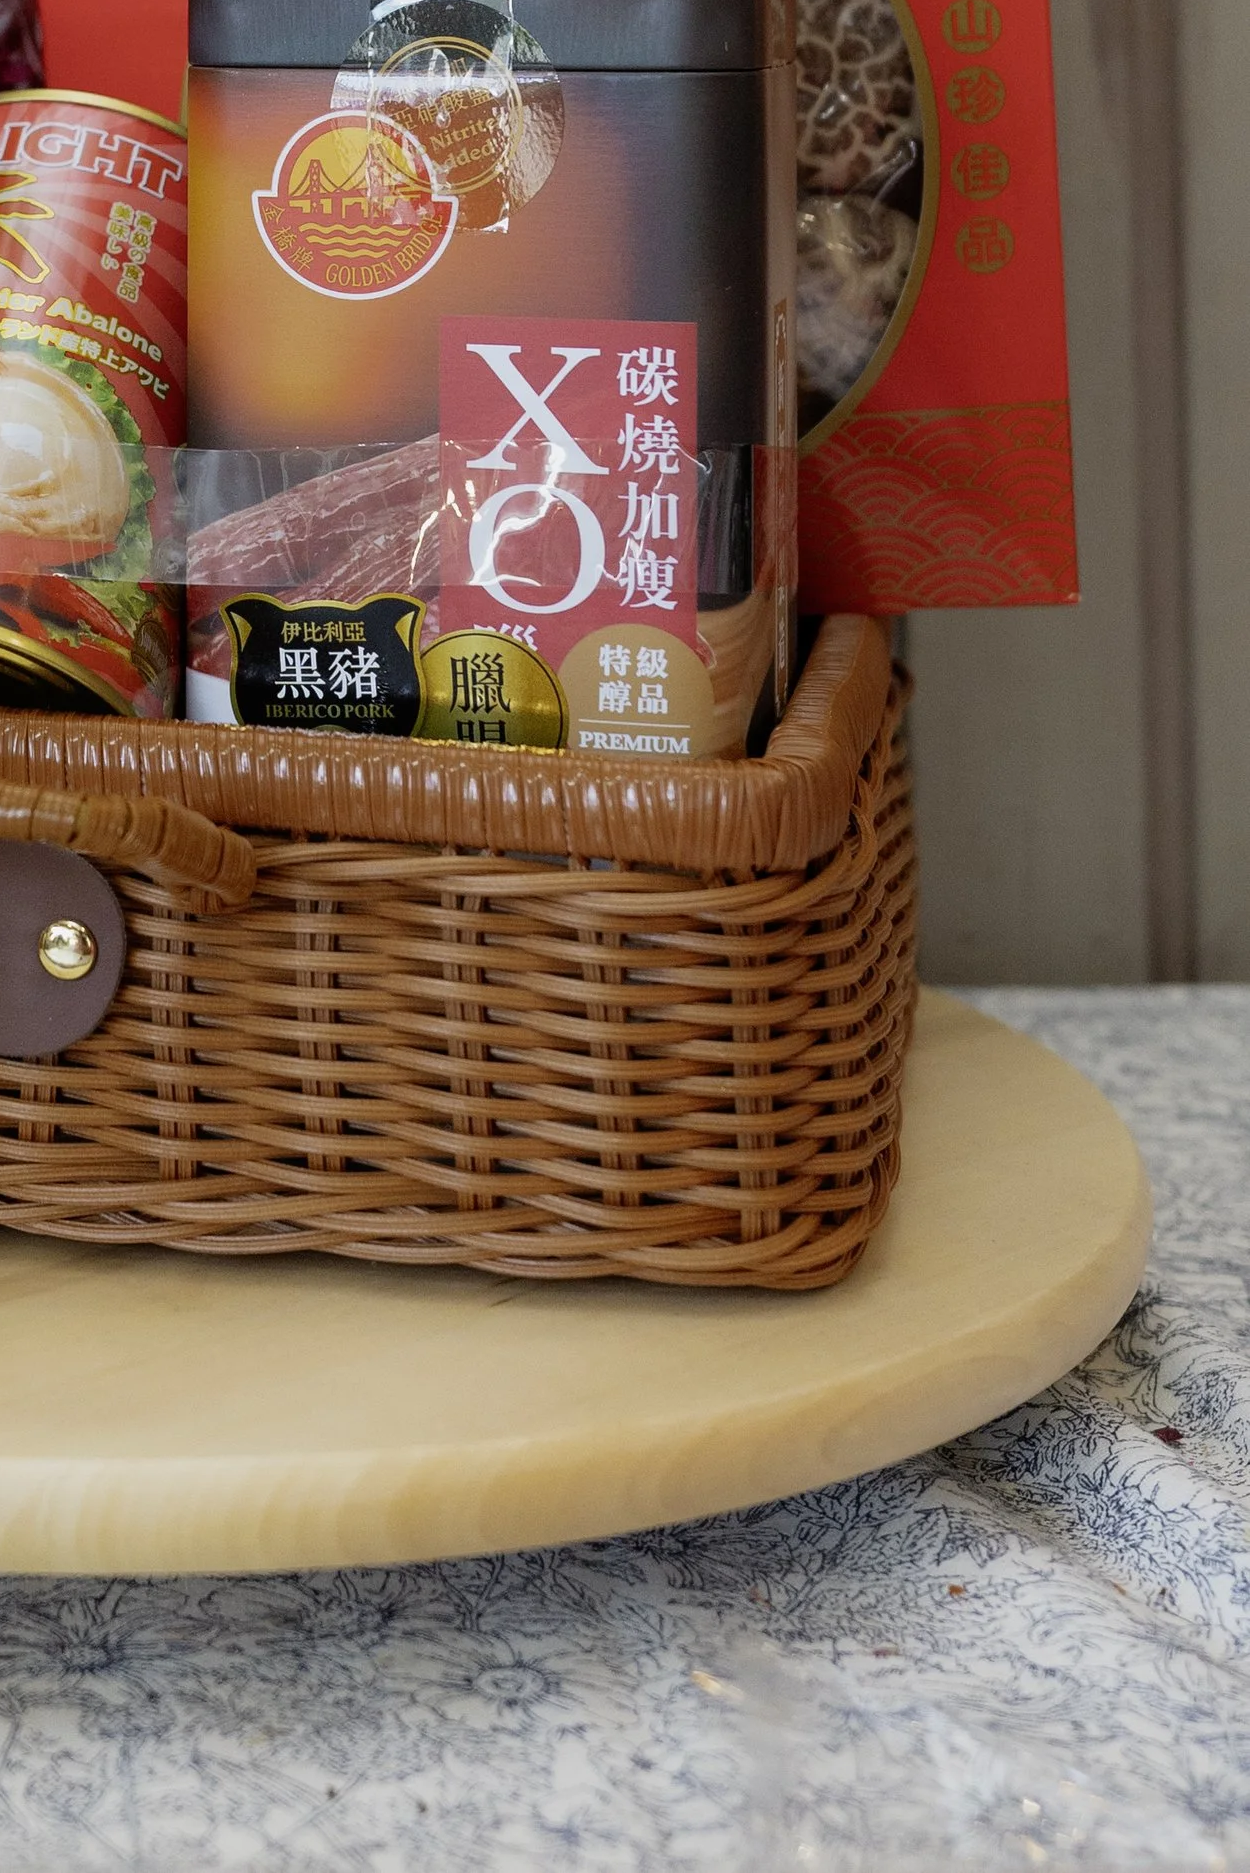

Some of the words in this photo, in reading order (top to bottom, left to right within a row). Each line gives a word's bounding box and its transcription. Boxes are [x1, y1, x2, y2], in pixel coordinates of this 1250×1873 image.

[325, 259, 398, 287] GOLDEN
[395, 213, 444, 273] BRIDGE
[46, 297, 163, 362] Abalone
[616, 346, 680, 611] 碳燒加瘦
[281, 620, 367, 644] 伊比利亞
[274, 646, 382, 700] 黑豬
[598, 644, 669, 679] 特級
[265, 704, 341, 720] IBERICO
[344, 703, 396, 720] PORK
[598, 680, 669, 715] 醇品
[579, 731, 691, 755] PREMIUM
